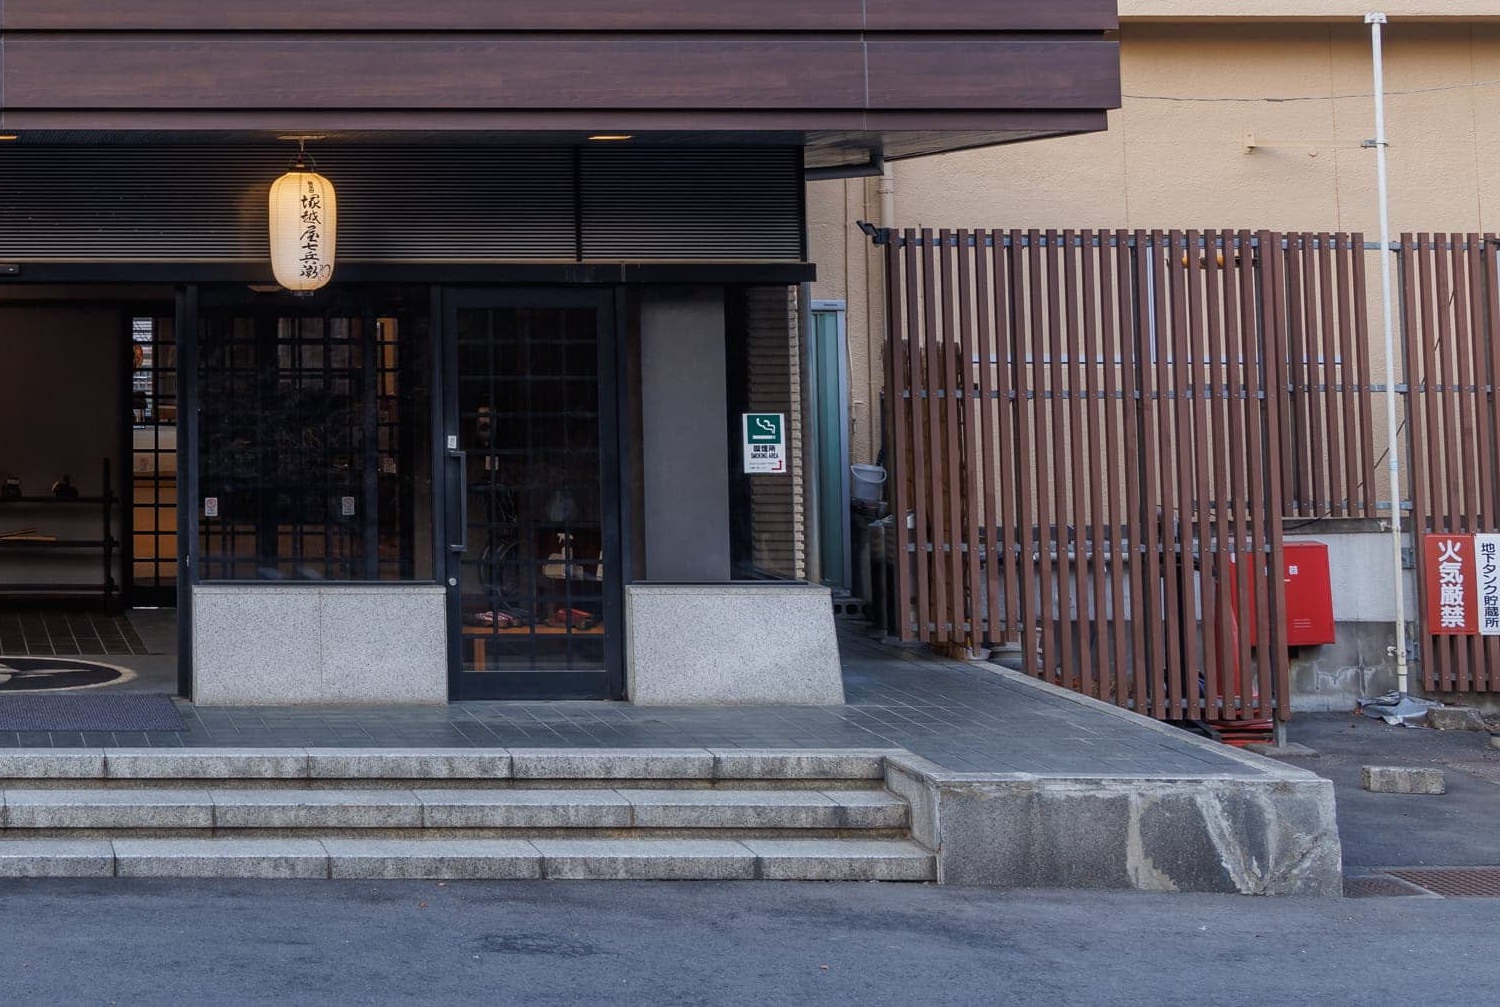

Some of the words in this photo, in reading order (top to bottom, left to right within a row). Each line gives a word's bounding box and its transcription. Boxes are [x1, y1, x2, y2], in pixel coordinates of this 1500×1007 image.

[1438, 539, 1465, 628] 火気厳禁
[1481, 542, 1499, 628] 地下タンク貯蔵所
